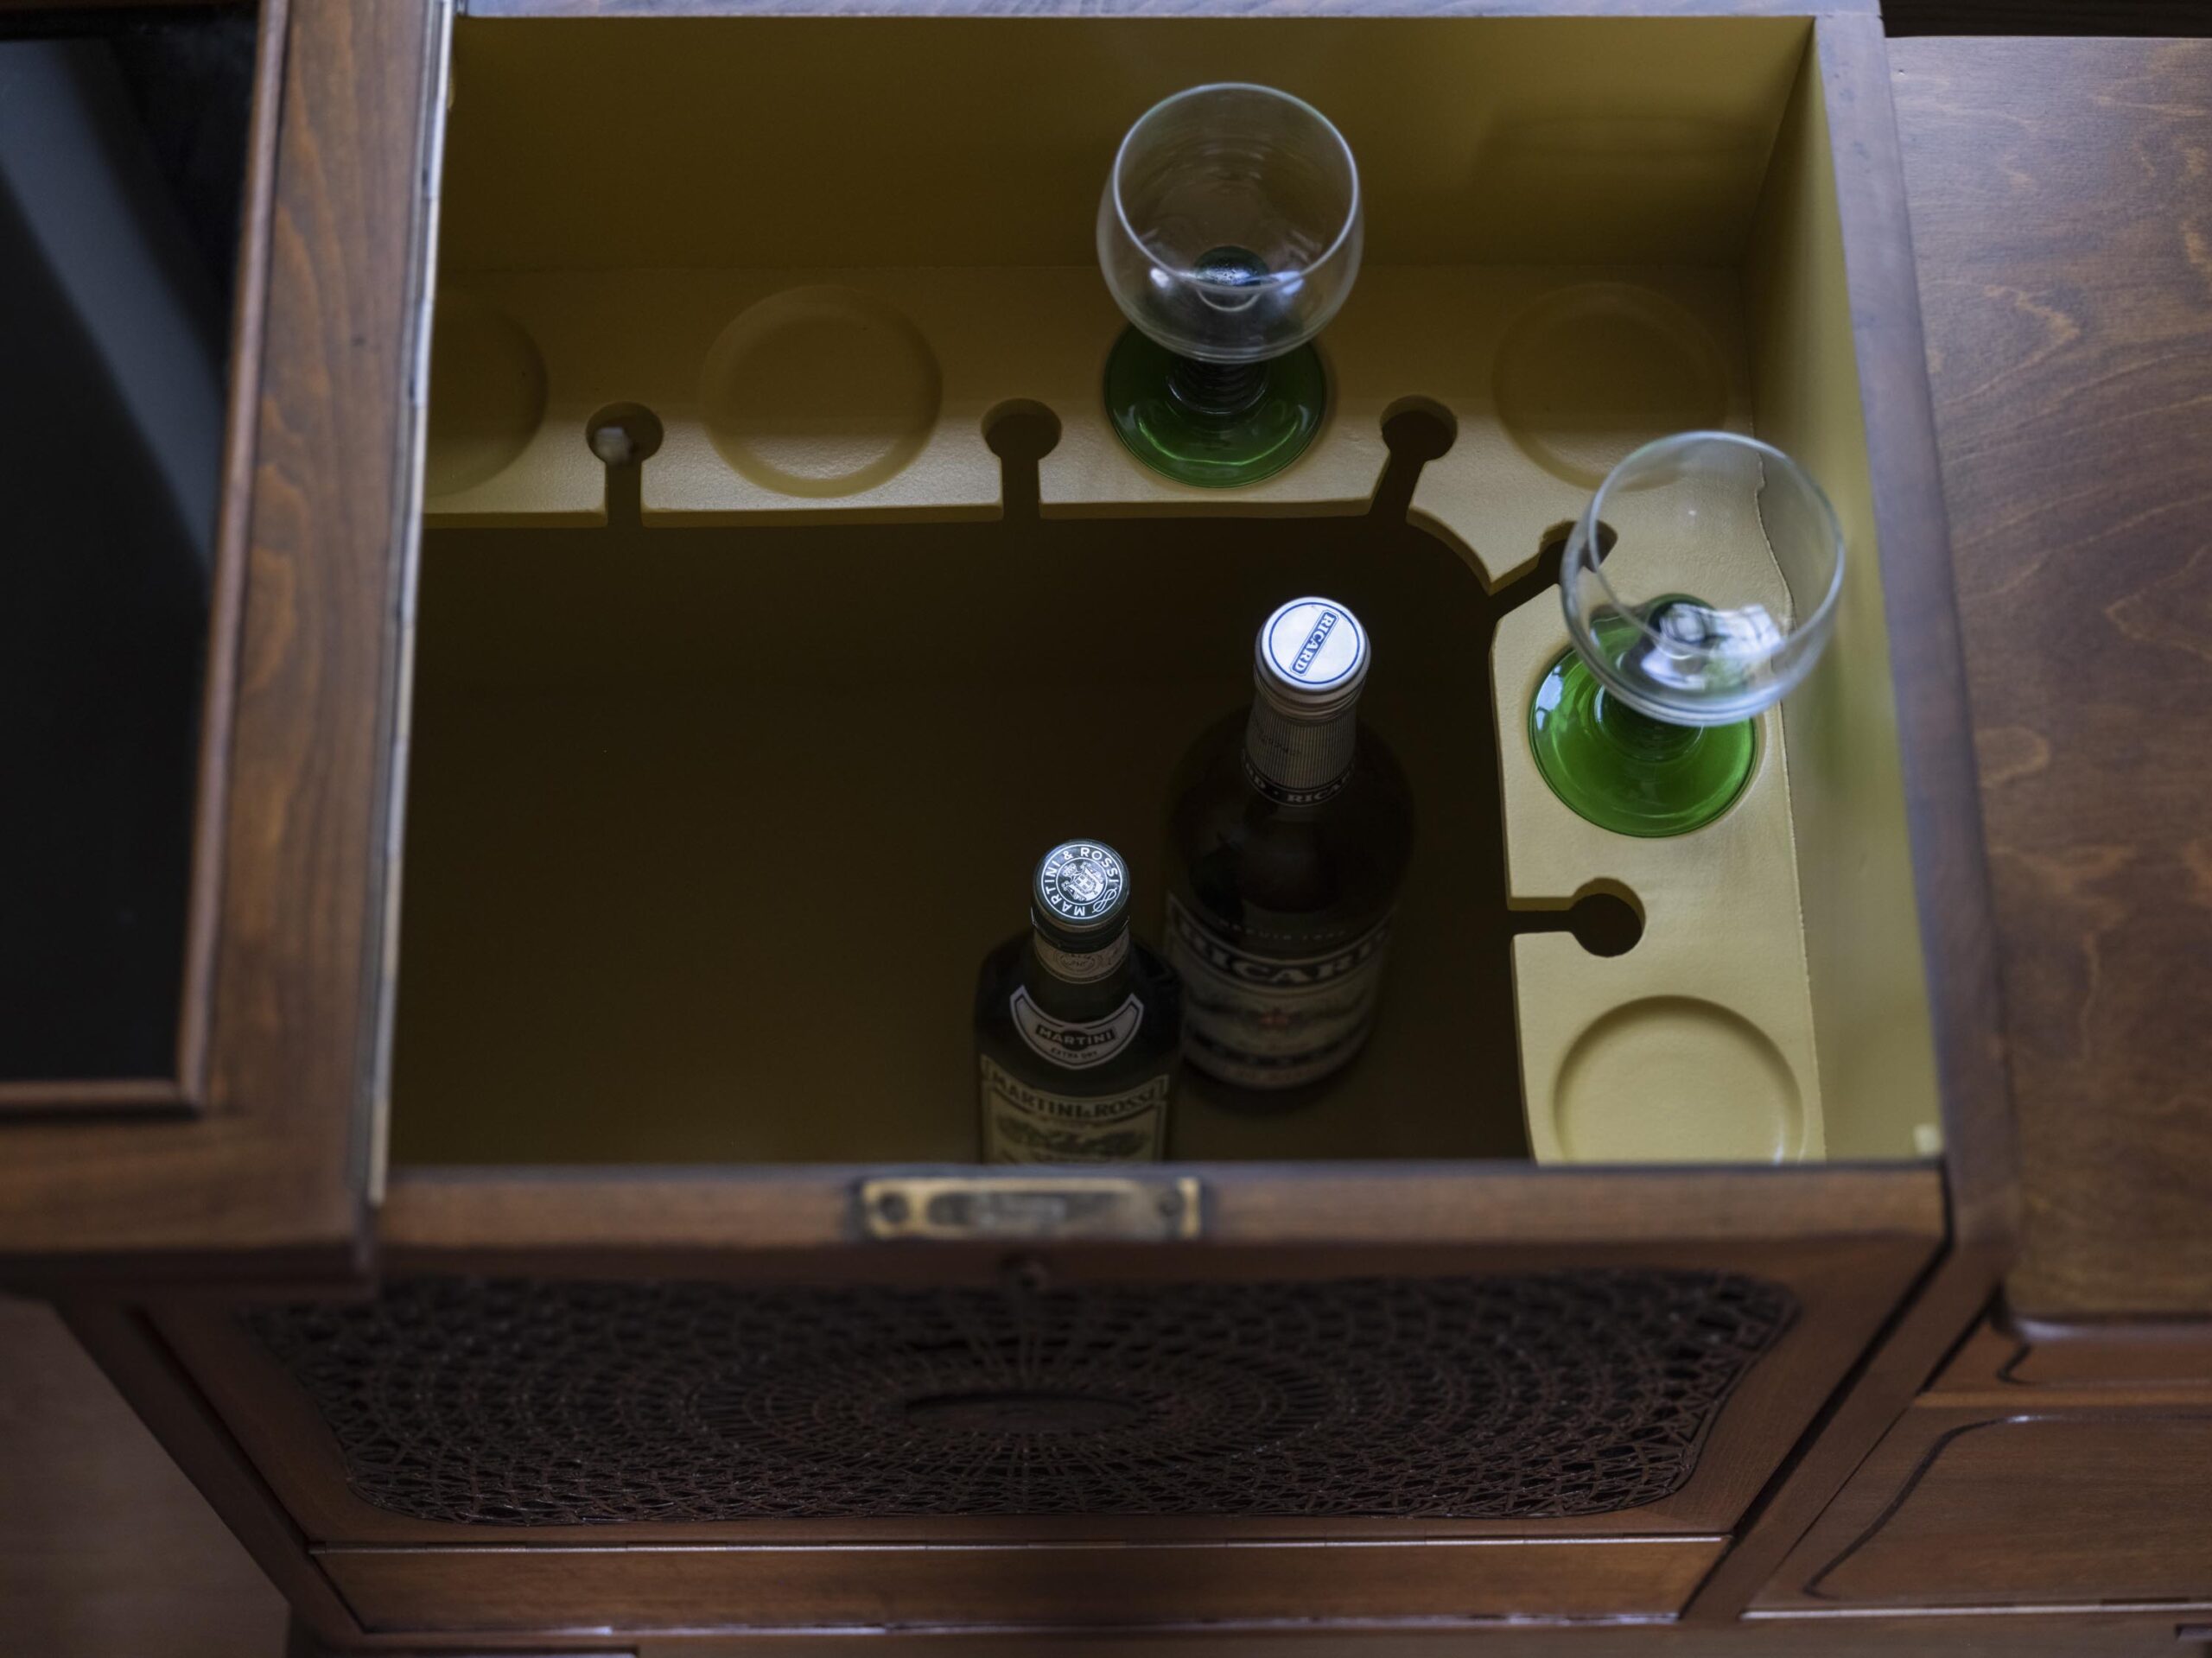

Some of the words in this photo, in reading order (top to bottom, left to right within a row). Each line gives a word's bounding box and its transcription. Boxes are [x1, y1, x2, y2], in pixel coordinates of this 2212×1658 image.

[1294, 612, 1336, 674] RICARD
[1062, 850, 1073, 861] &
[1080, 847, 1119, 883] ROSSI
[1044, 860, 1085, 917] MARTINI
[1038, 1027, 1112, 1045] MARTINI
